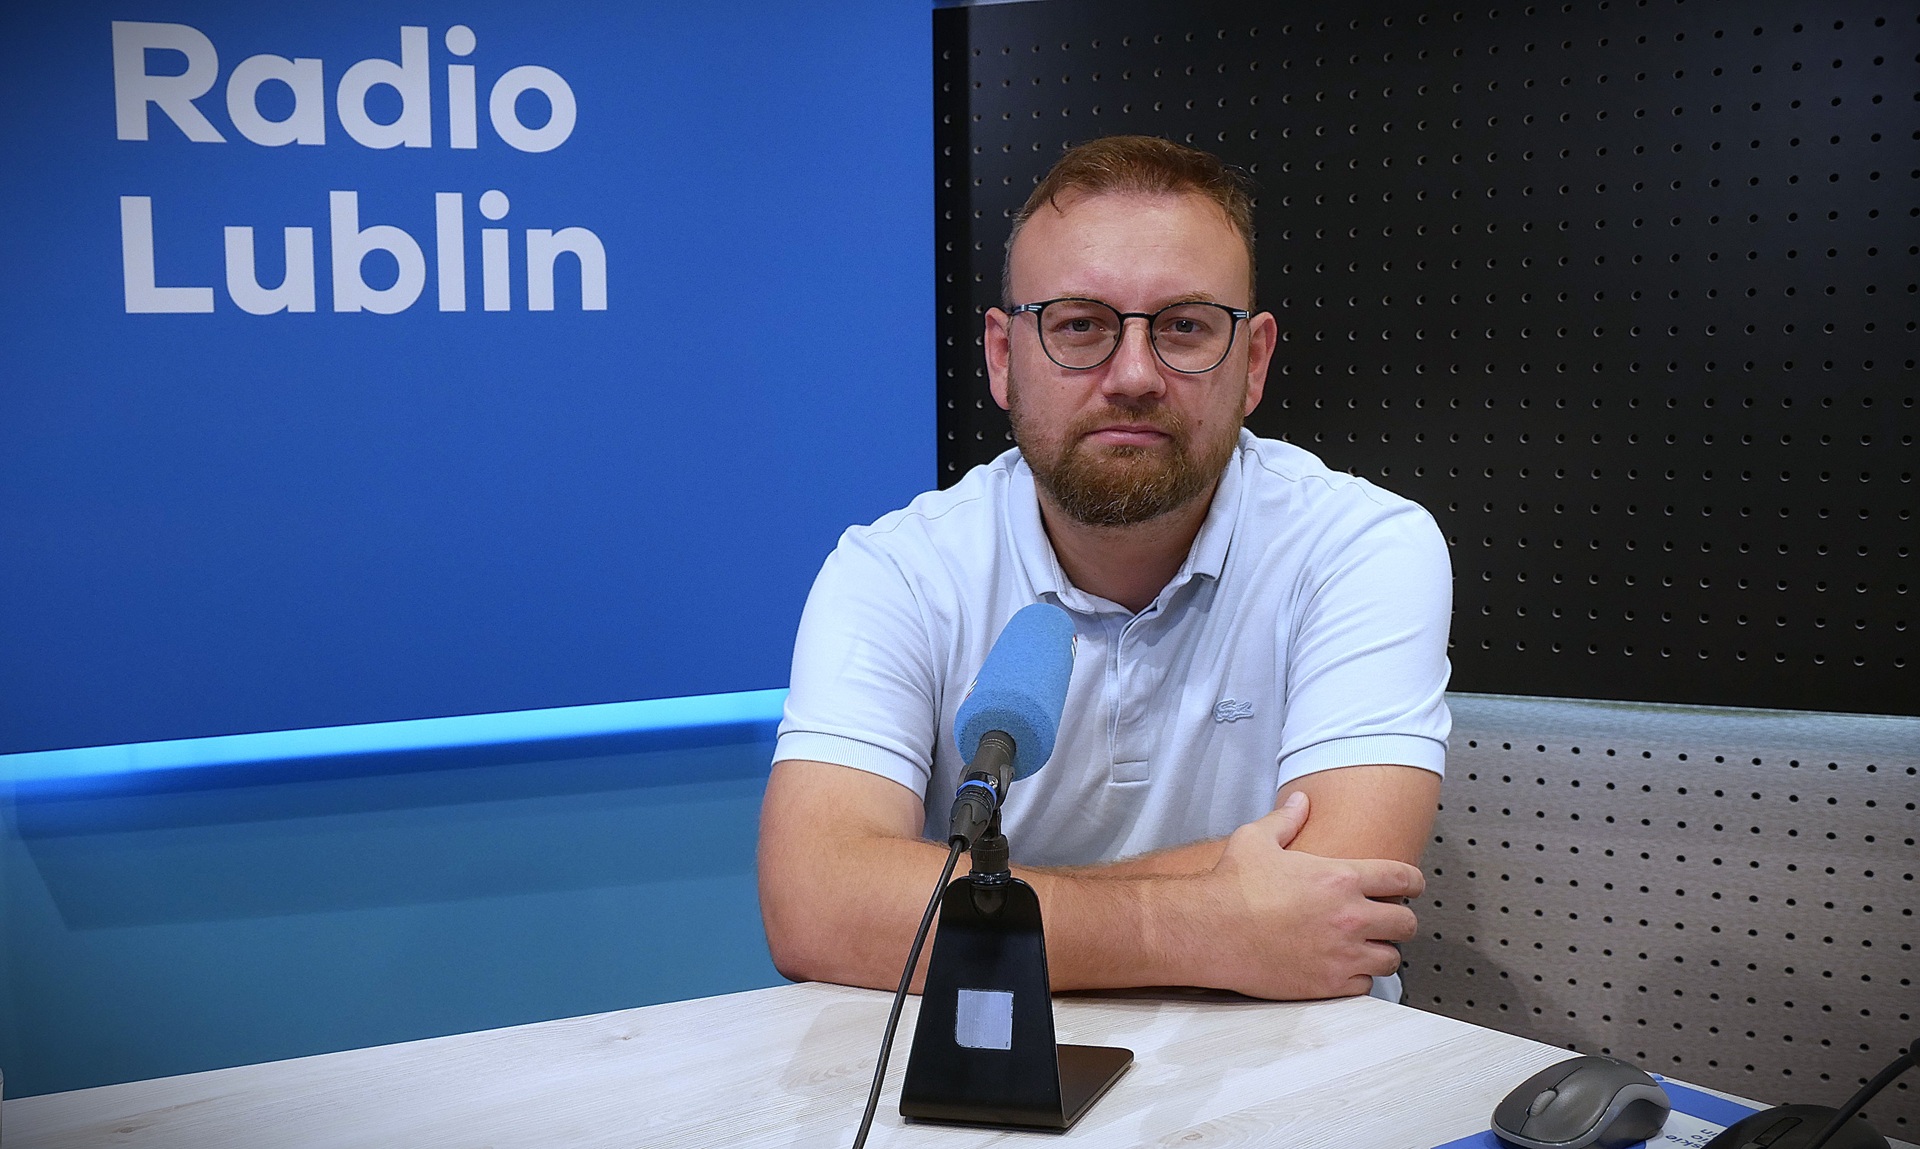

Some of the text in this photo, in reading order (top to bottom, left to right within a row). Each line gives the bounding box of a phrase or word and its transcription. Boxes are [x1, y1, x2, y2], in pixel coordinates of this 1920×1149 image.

[111, 21, 577, 153] Radio
[120, 189, 608, 315] Lublin
[1691, 1135, 1708, 1144] io
